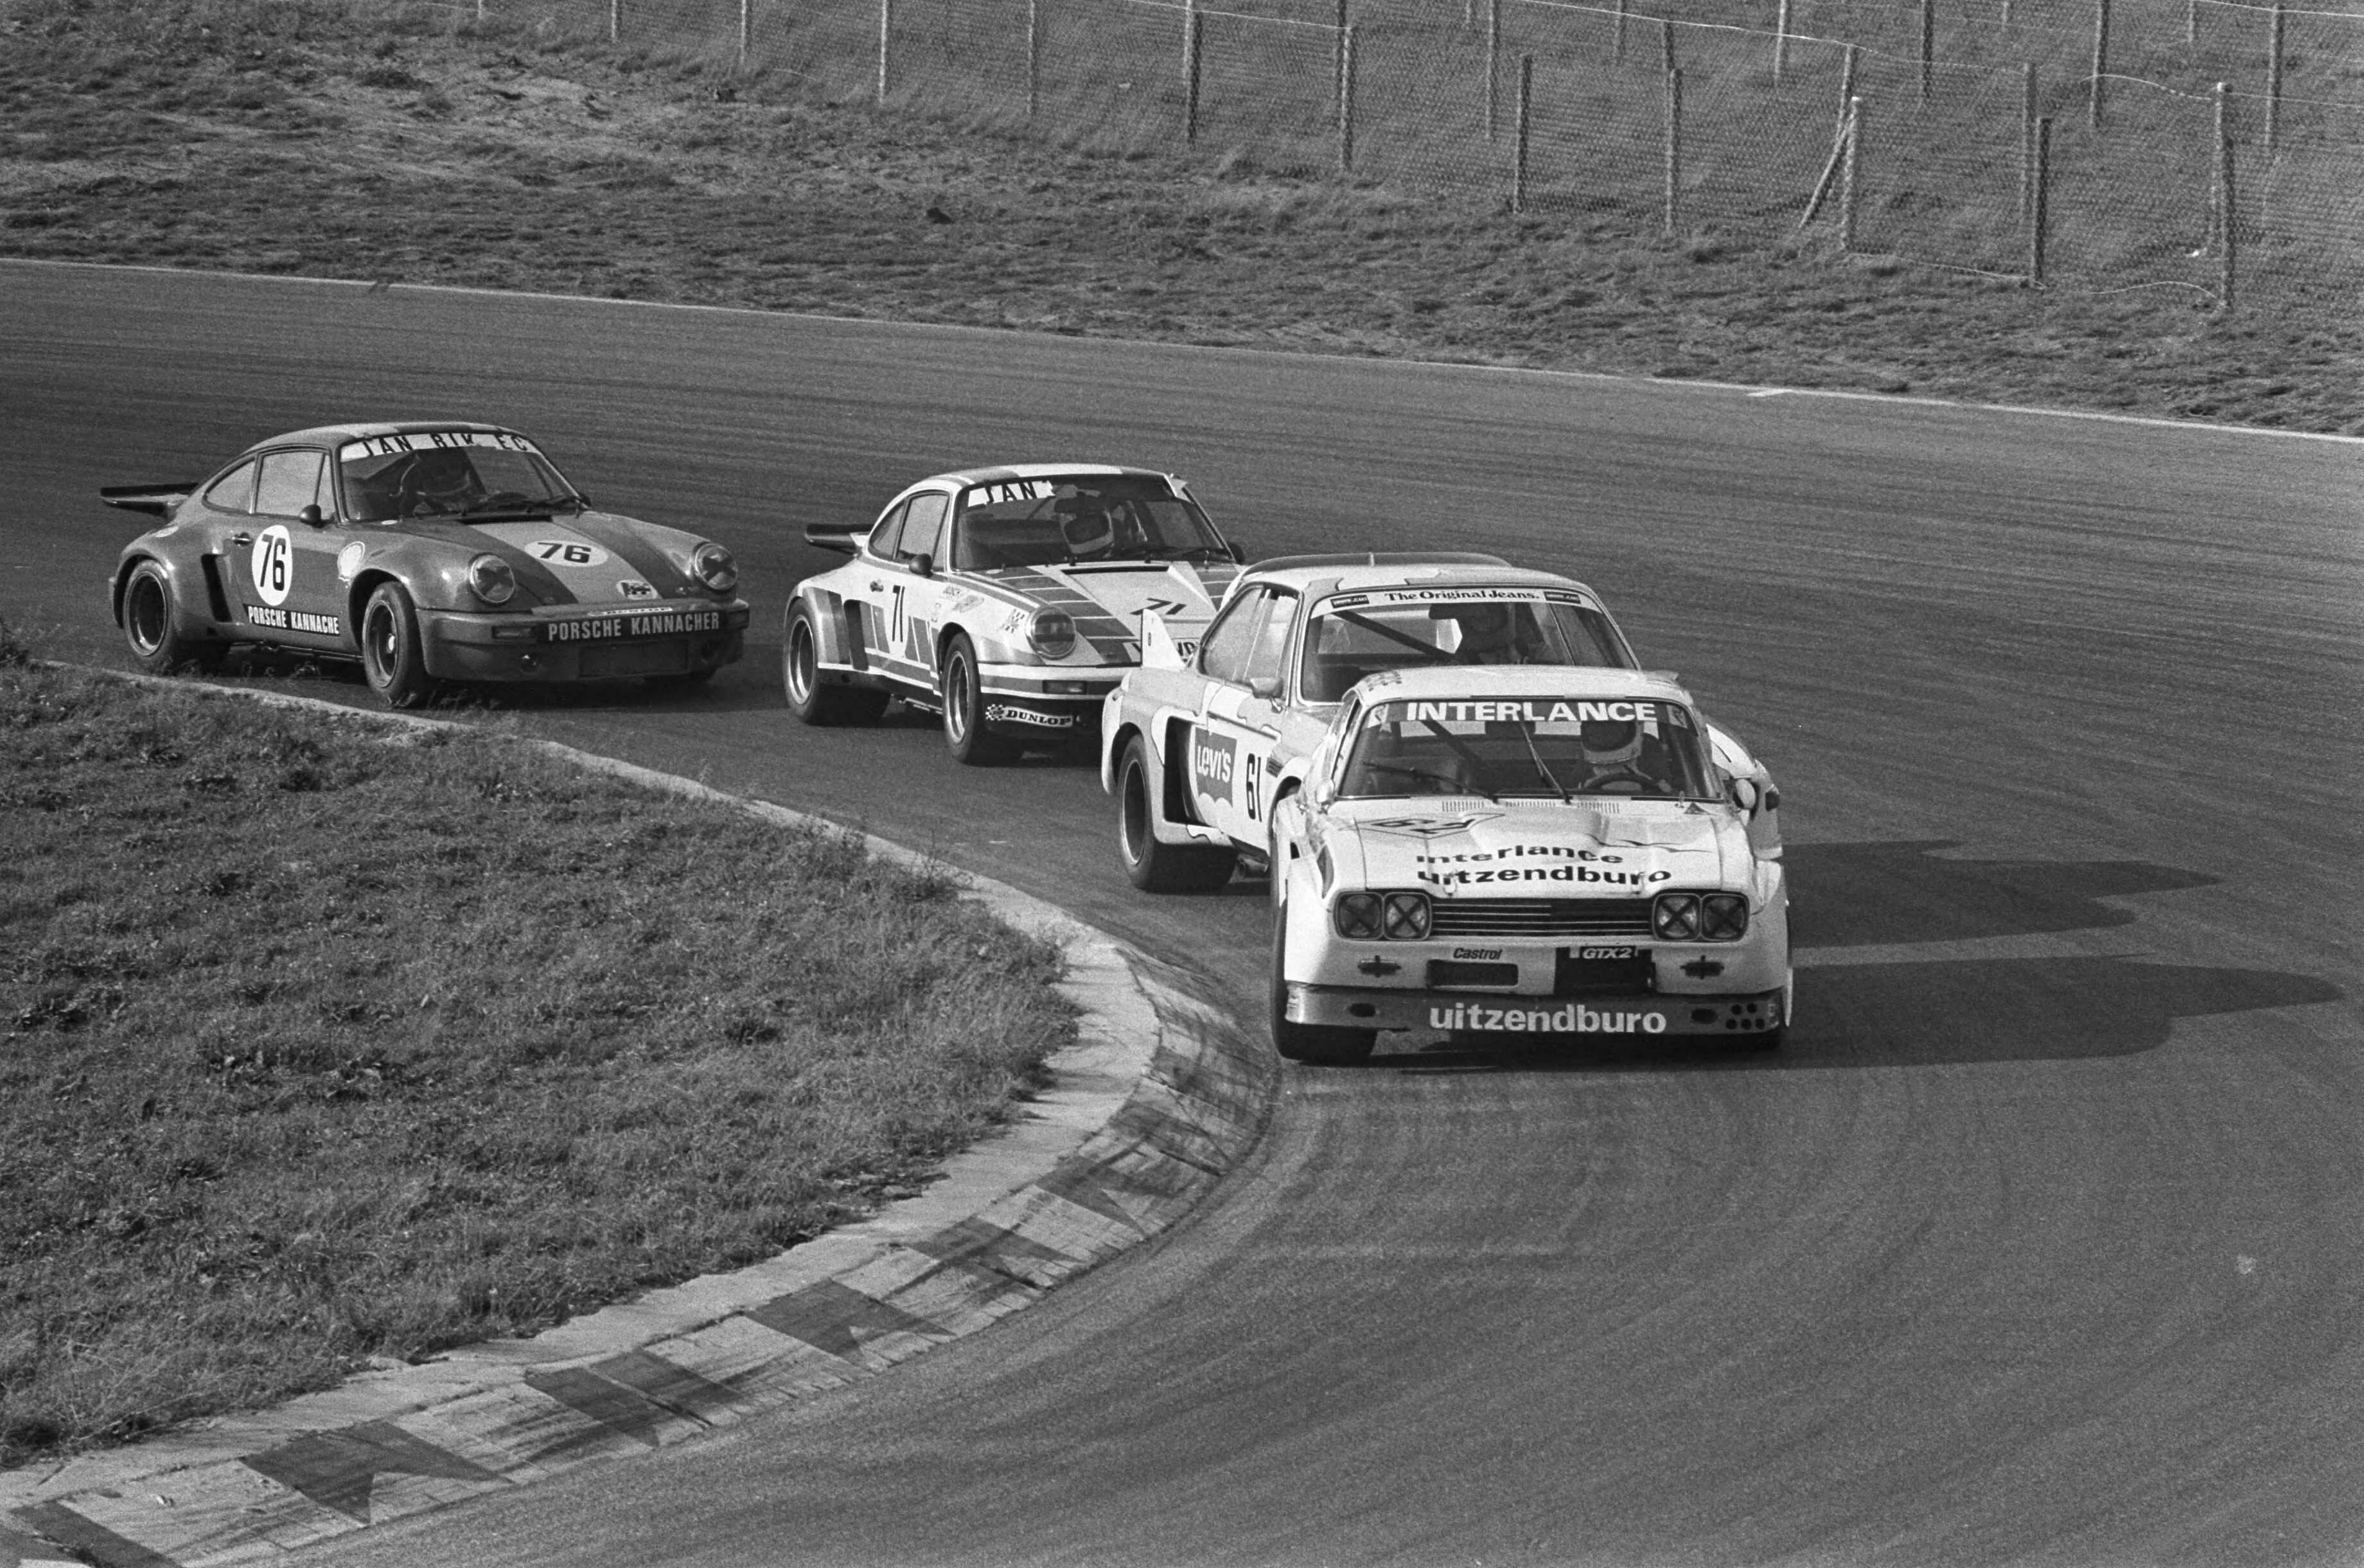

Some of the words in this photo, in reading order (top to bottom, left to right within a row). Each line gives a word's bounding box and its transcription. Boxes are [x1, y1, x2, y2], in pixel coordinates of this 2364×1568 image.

[260, 534, 287, 592] 76
[538, 542, 591, 563] 76
[1129, 597, 1187, 615] 71
[1385, 592, 1416, 601] The
[1419, 590, 1486, 600] Original
[1488, 590, 1540, 599] Jeans.
[248, 606, 287, 628] PORSCHE
[892, 585, 905, 642] 71
[549, 618, 621, 641] PORSCHE
[631, 612, 719, 635] KANNACHER
[1006, 709, 1071, 725] DUNLOP
[1407, 701, 1657, 721] INTERLANCE
[1246, 753, 1262, 822] 61
[1416, 845, 1623, 863] interlance
[1418, 865, 1672, 886] uitzendburo
[1452, 947, 1503, 960] Castrol
[1582, 947, 1632, 959] GTX2
[1429, 1003, 1667, 1033] uitzendburo
